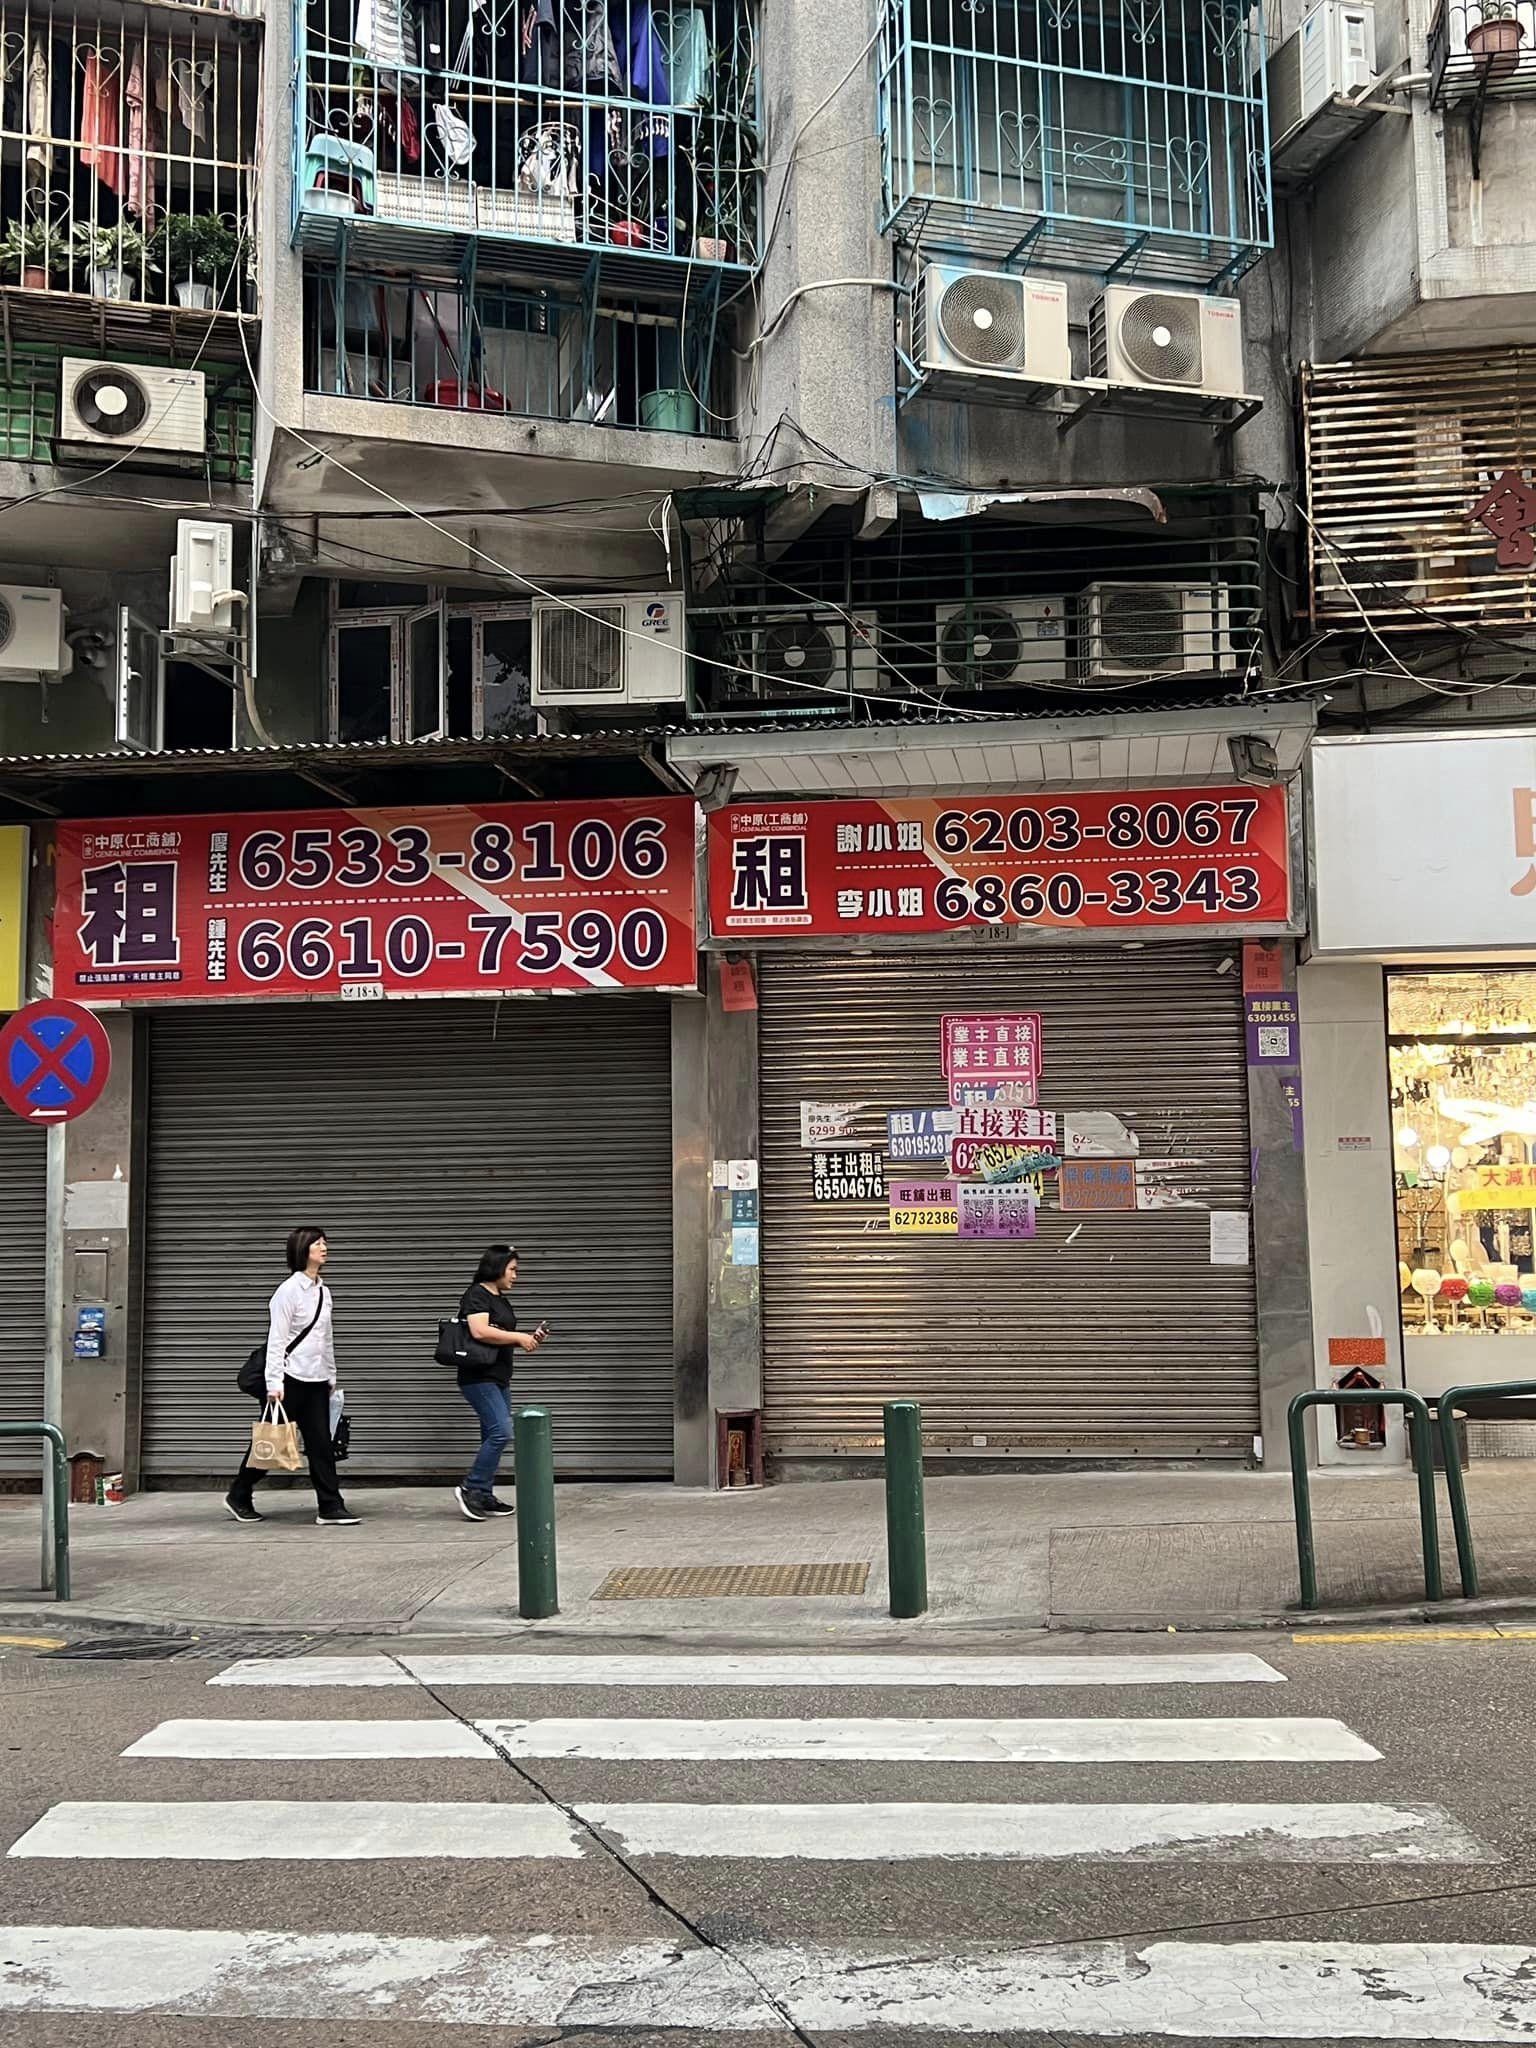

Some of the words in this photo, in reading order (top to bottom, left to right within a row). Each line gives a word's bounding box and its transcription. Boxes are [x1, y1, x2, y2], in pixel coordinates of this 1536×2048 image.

[1031, 294, 1059, 302] TOSHIBA
[1207, 311, 1234, 319] TOSHIBA
[642, 619, 669, 627] GREE
[837, 822, 923, 853] 謝小姐
[933, 798, 1260, 854] 6203-8067
[238, 818, 669, 890] 6533-8106
[731, 835, 808, 910] 租
[837, 887, 924, 918] 李小姐
[933, 865, 1261, 920] 6860-3343
[77, 861, 181, 968] 租
[237, 907, 669, 981] 6610-7590
[1247, 1013, 1296, 1023] 63091455
[952, 1046, 1031, 1068] 業主直接
[809, 1126, 835, 1136] 6299
[956, 1108, 1054, 1137] 直接業主
[891, 1134, 944, 1157] 63019528
[814, 1152, 874, 1178] 業主出租
[815, 1177, 883, 1200] 65504676
[894, 1211, 959, 1225] 62732386
